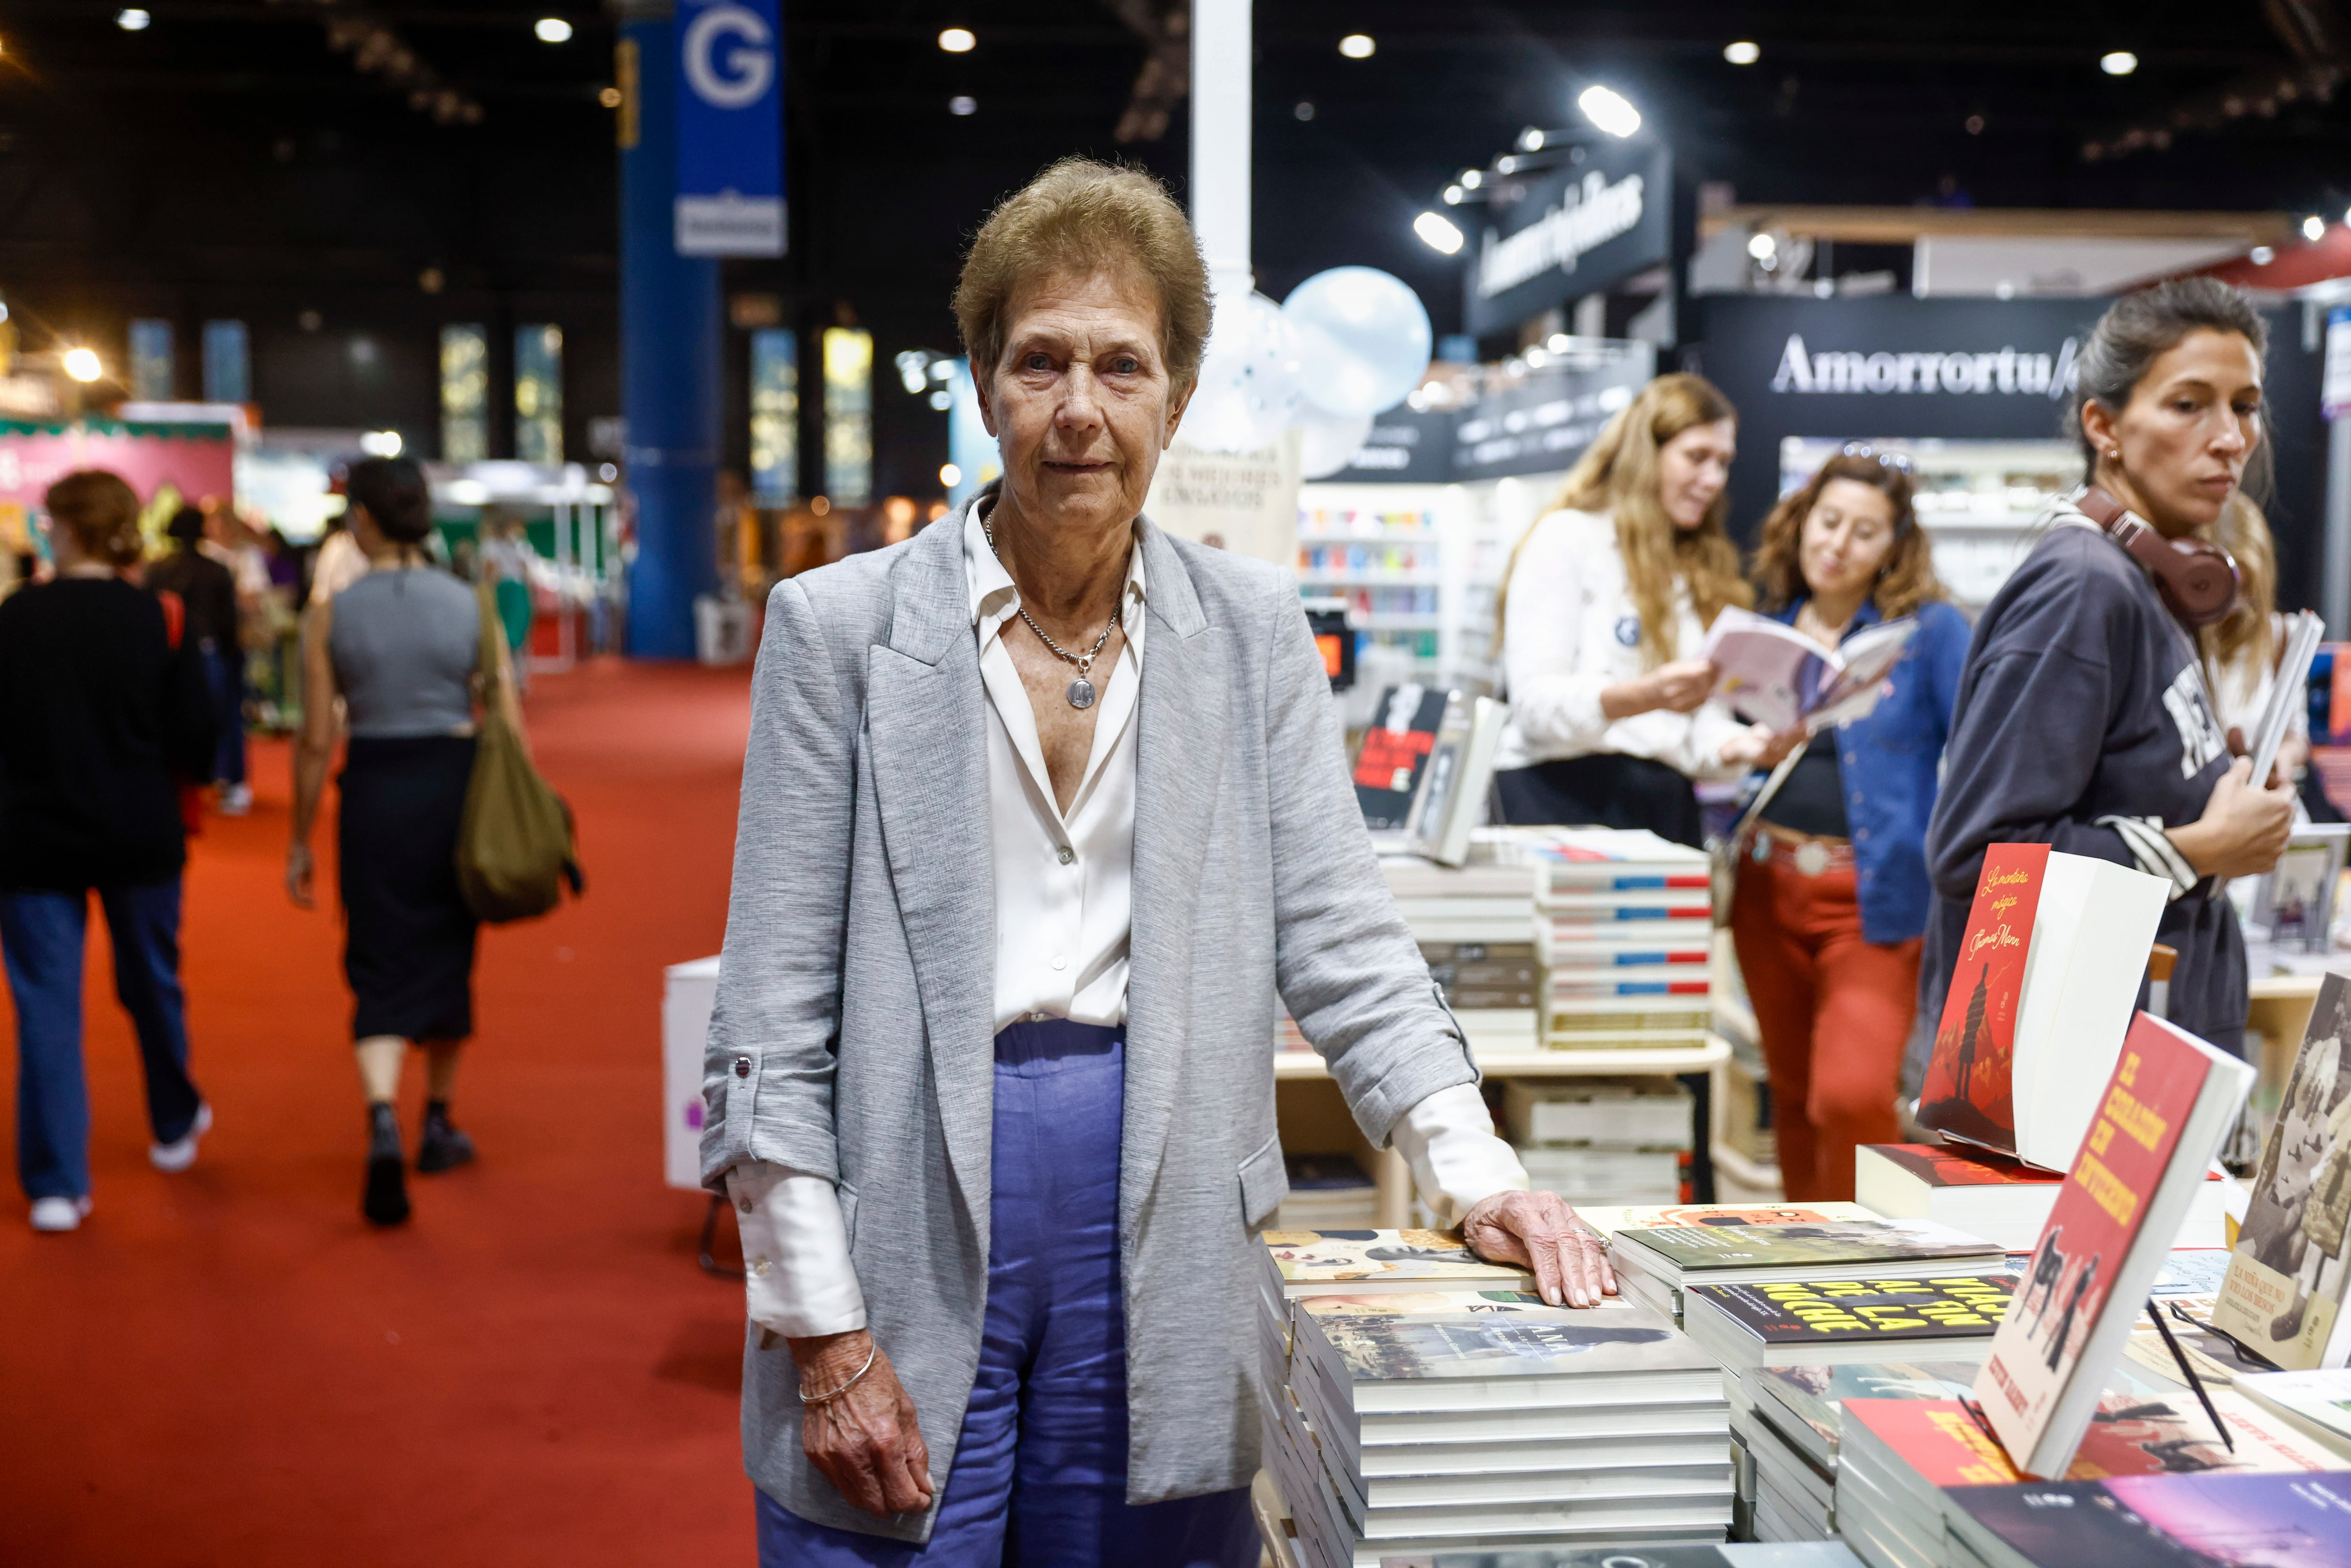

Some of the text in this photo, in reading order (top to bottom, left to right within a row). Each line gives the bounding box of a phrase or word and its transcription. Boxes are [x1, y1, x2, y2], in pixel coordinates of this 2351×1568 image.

[683, 6, 774, 108] G
[1981, 866, 2028, 897] La montaña
[1991, 893, 2017, 920] mágica
[1968, 924, 2020, 961] Thomas Mann
[2229, 1279, 2241, 1294] VIO
[2241, 1286, 2254, 1302] LOS
[2253, 1293, 2276, 1315] BESOS
[2234, 1265, 2242, 1279] LA
[2259, 1280, 2274, 1297] QUE
[2274, 1288, 2285, 1302] NO
[1752, 1284, 1871, 1333] NOCHE
[1808, 1282, 1928, 1330] DE LA
[1866, 1281, 1991, 1325] AL FIN
[1432, 1324, 1453, 1344] MERCEDES
[1490, 1326, 1518, 1352] FUNDADORA
[1527, 1324, 1575, 1352] ANA
